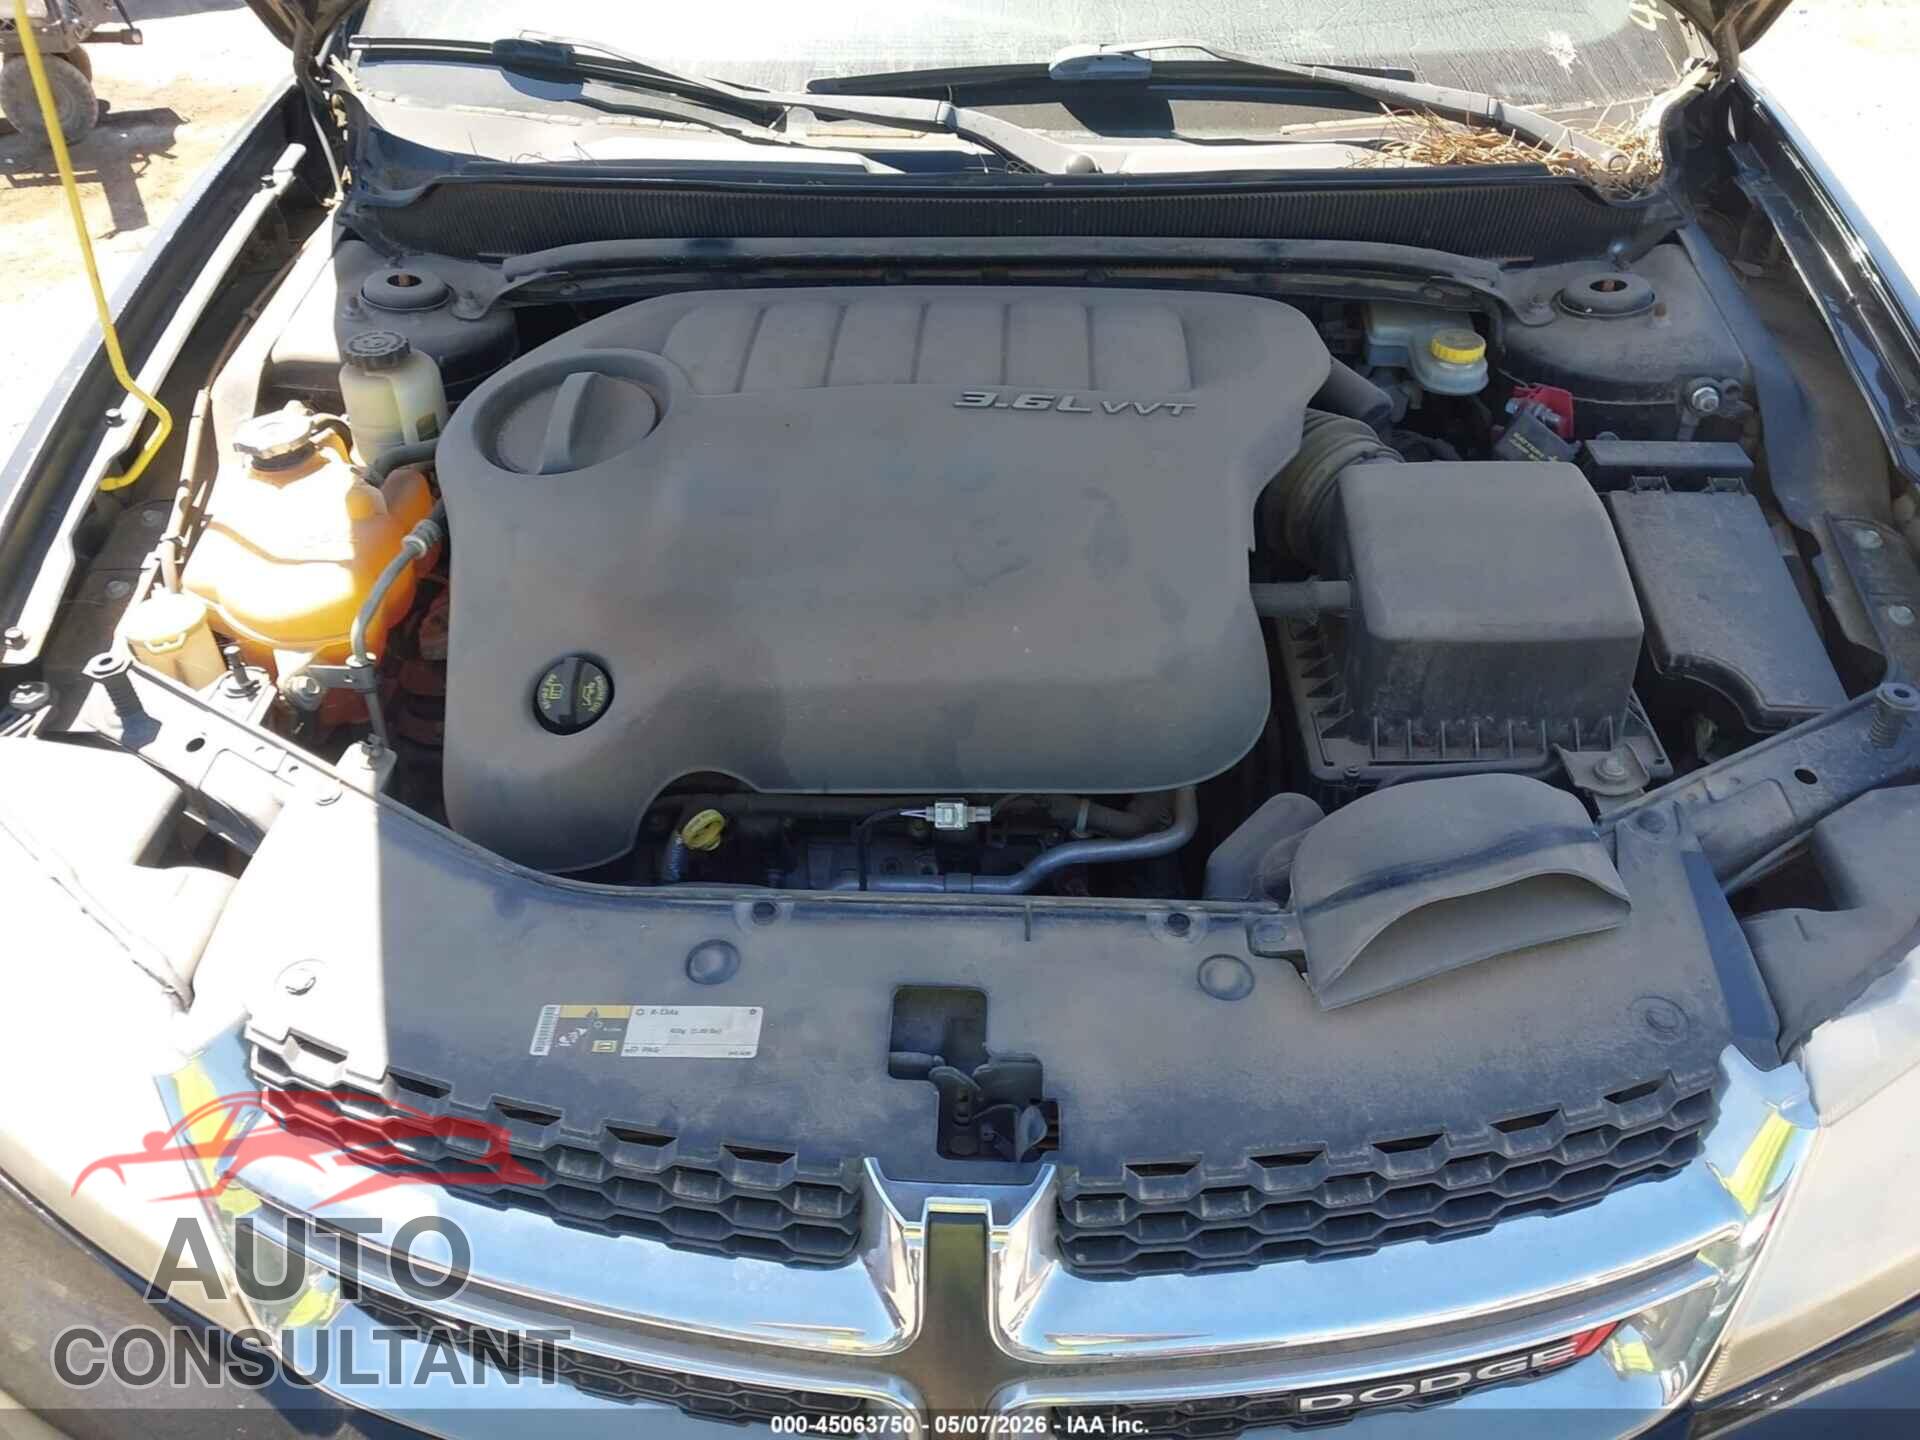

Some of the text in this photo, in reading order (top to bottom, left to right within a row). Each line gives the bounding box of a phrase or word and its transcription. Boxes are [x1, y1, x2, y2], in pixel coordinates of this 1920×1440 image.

[953, 391, 1197, 416] 3.6L VVT
[1300, 1342, 1578, 1412] DODGE
